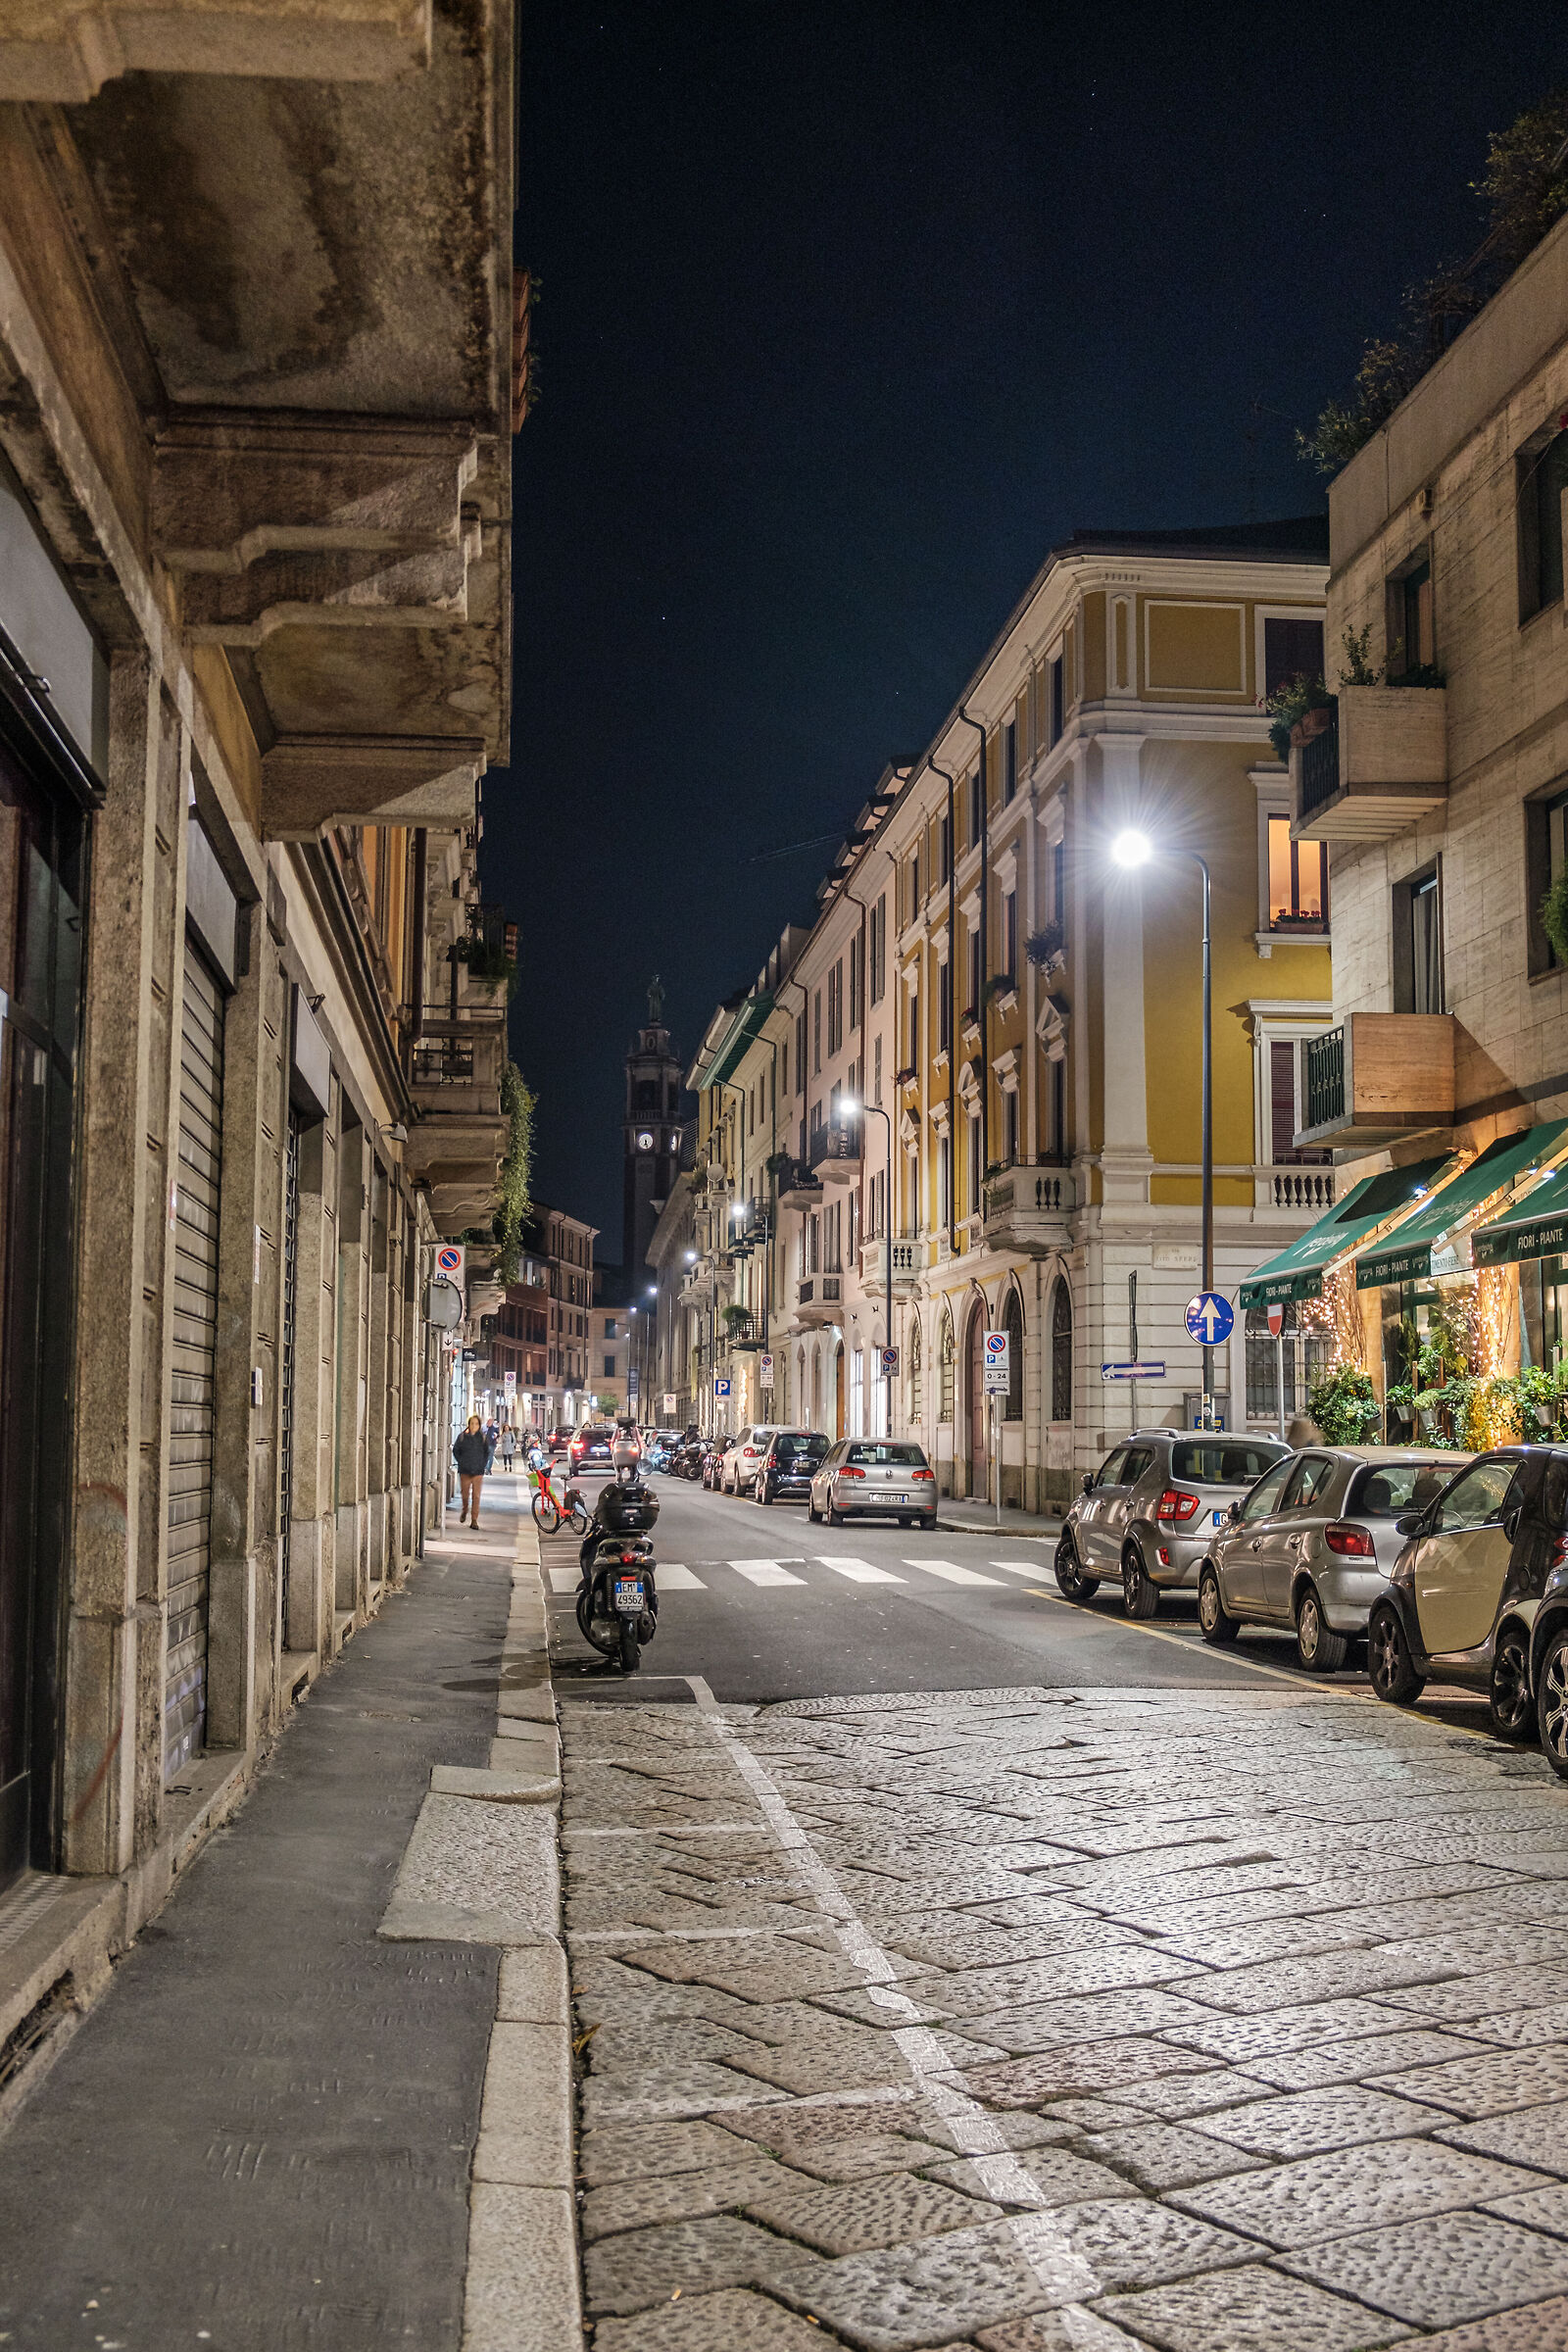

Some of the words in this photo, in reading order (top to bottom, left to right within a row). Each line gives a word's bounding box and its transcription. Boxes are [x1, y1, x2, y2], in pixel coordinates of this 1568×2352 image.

[1518, 1234, 1535, 1250] FIORI
[1540, 1228, 1563, 1246] PIANTE
[1375, 1264, 1389, 1277] FIORI
[1392, 1259, 1409, 1273] PIANTE
[1266, 1285, 1276, 1297] FIORI
[1278, 1283, 1292, 1296] PIANTE
[717, 1382, 728, 1395] P
[617, 1594, 643, 1605] 49362
